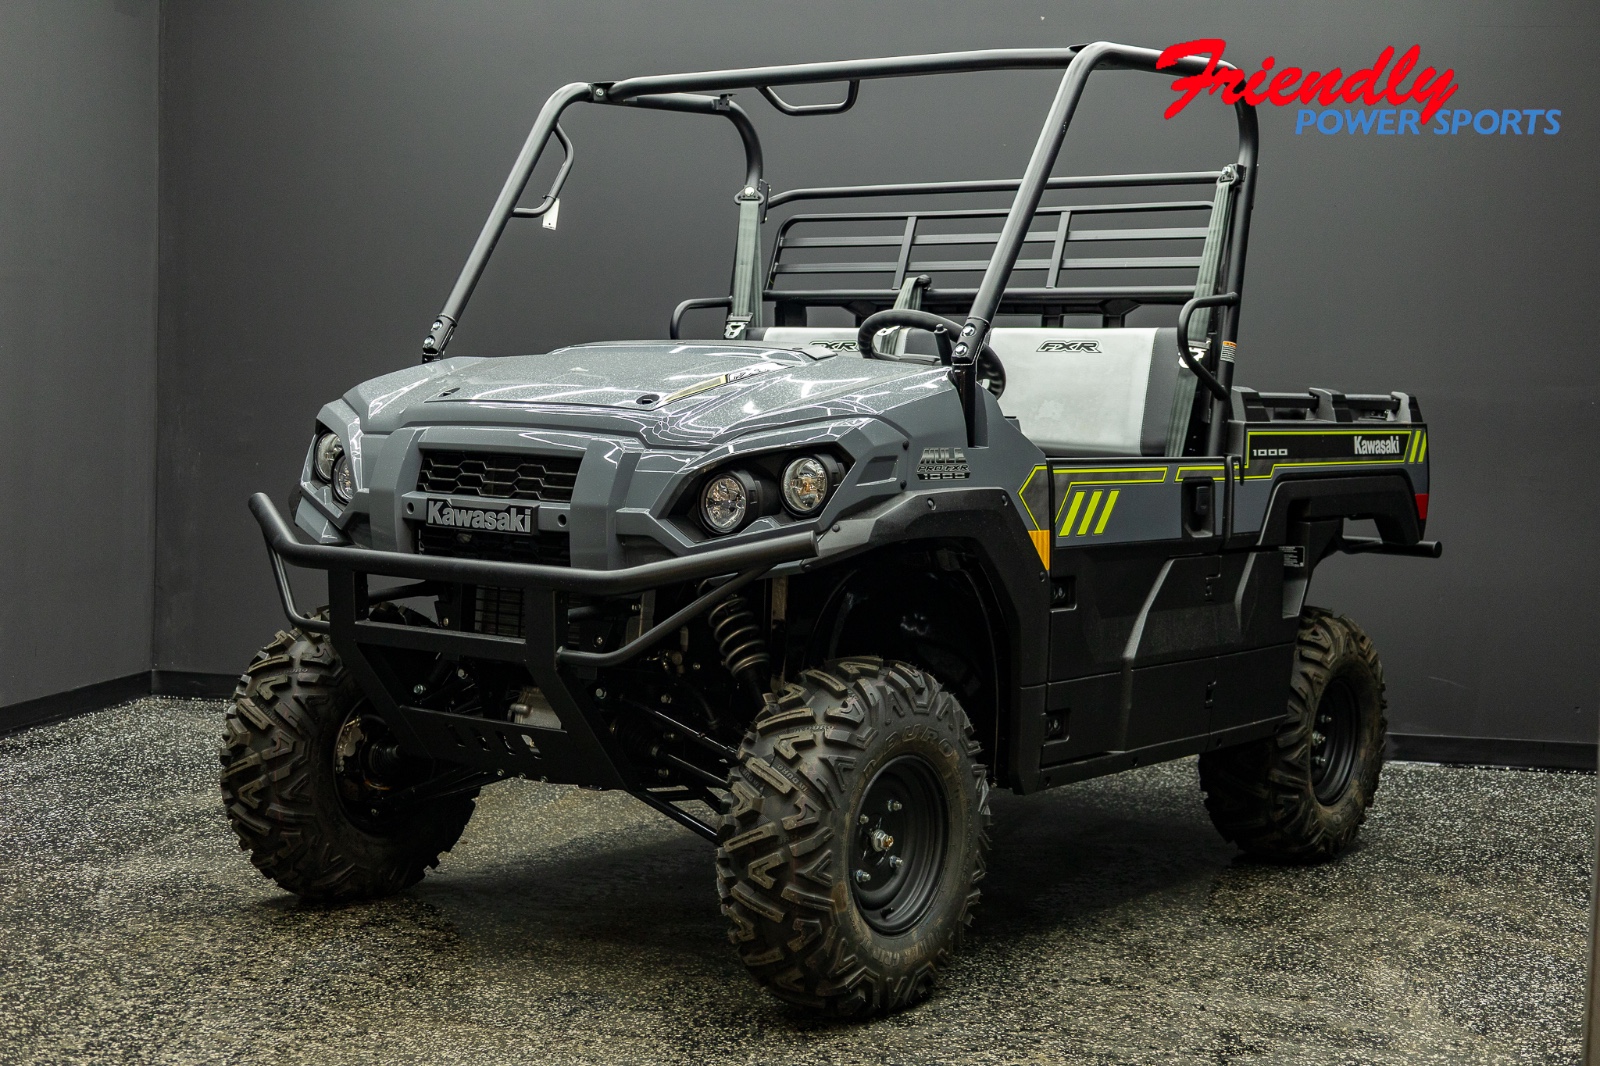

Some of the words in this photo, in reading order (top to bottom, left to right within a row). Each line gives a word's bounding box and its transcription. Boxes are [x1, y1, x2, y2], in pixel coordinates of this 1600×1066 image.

[1038, 341, 1100, 352] FXR
[1253, 448, 1288, 456] 1000
[1354, 436, 1399, 454] Kawasaki
[919, 447, 967, 464] MULE
[427, 500, 532, 533] Kawasaki
